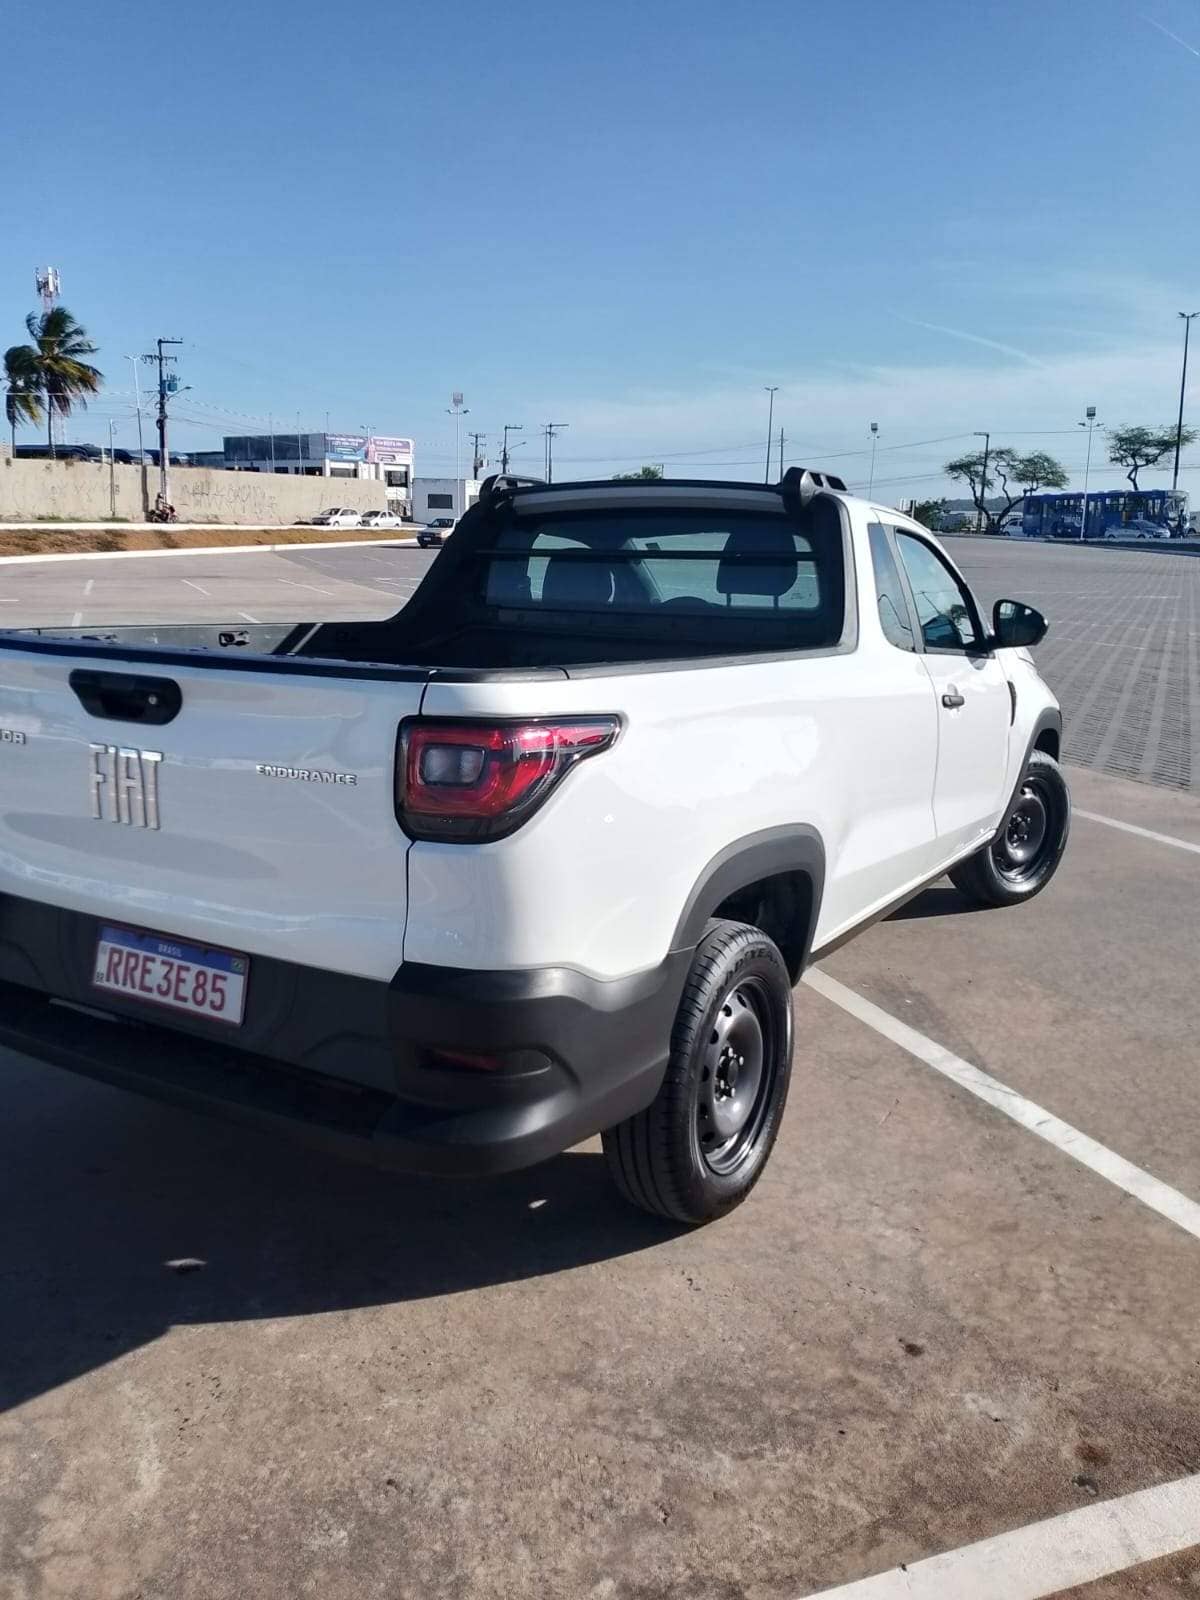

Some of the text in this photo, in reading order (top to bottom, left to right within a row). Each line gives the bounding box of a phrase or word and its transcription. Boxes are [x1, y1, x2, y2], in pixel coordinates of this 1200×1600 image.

[89, 743, 163, 830] FIAT
[255, 764, 357, 786] ENDURANCE
[158, 943, 182, 958] BRASIL
[105, 947, 228, 1012] RRE3E85
